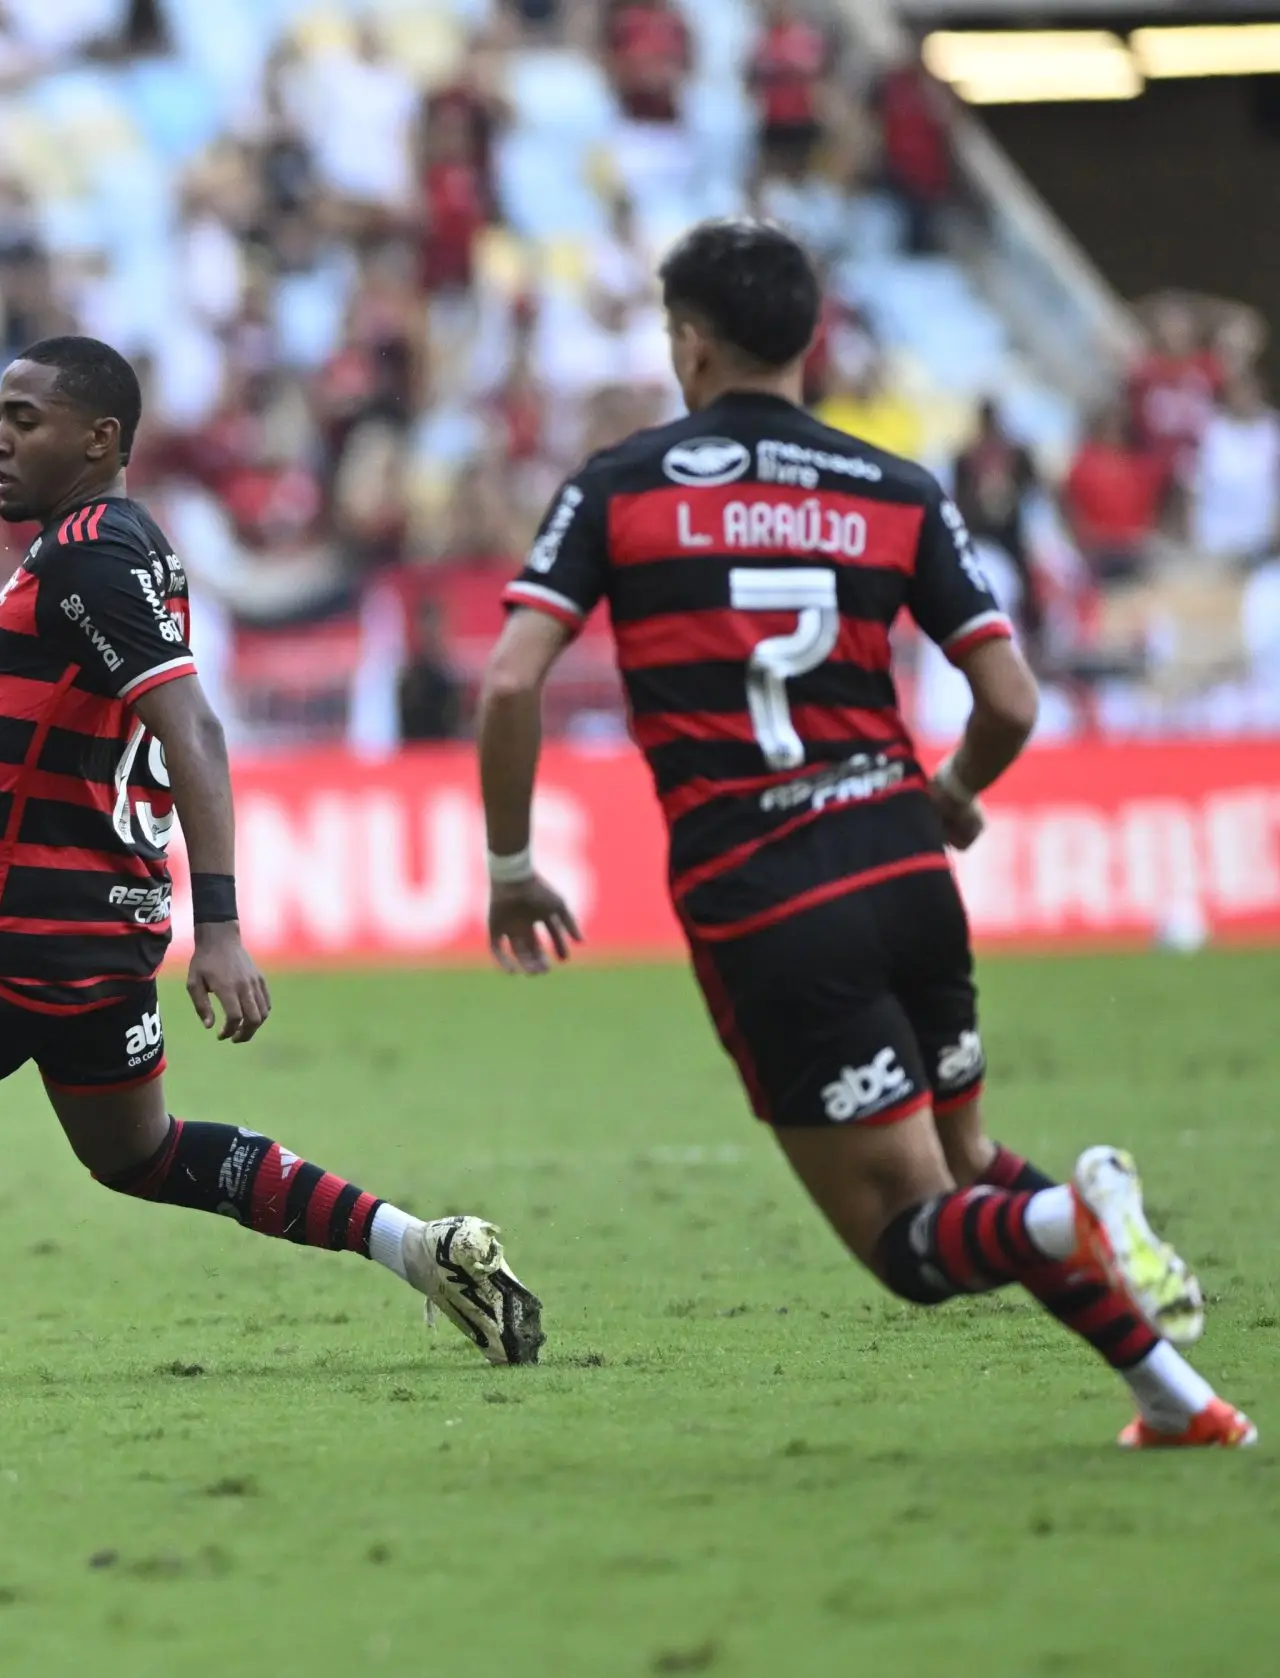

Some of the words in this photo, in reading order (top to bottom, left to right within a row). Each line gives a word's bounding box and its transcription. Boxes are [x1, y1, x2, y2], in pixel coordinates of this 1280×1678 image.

[757, 439, 882, 482] mercado
[757, 460, 819, 490] livre
[677, 501, 713, 547] L.
[723, 498, 867, 557] ARAÚJO
[130, 568, 168, 620] kwai
[80, 615, 124, 672] kwai
[729, 568, 840, 770] 7
[125, 1002, 161, 1055] ab
[821, 1046, 906, 1121] abc
